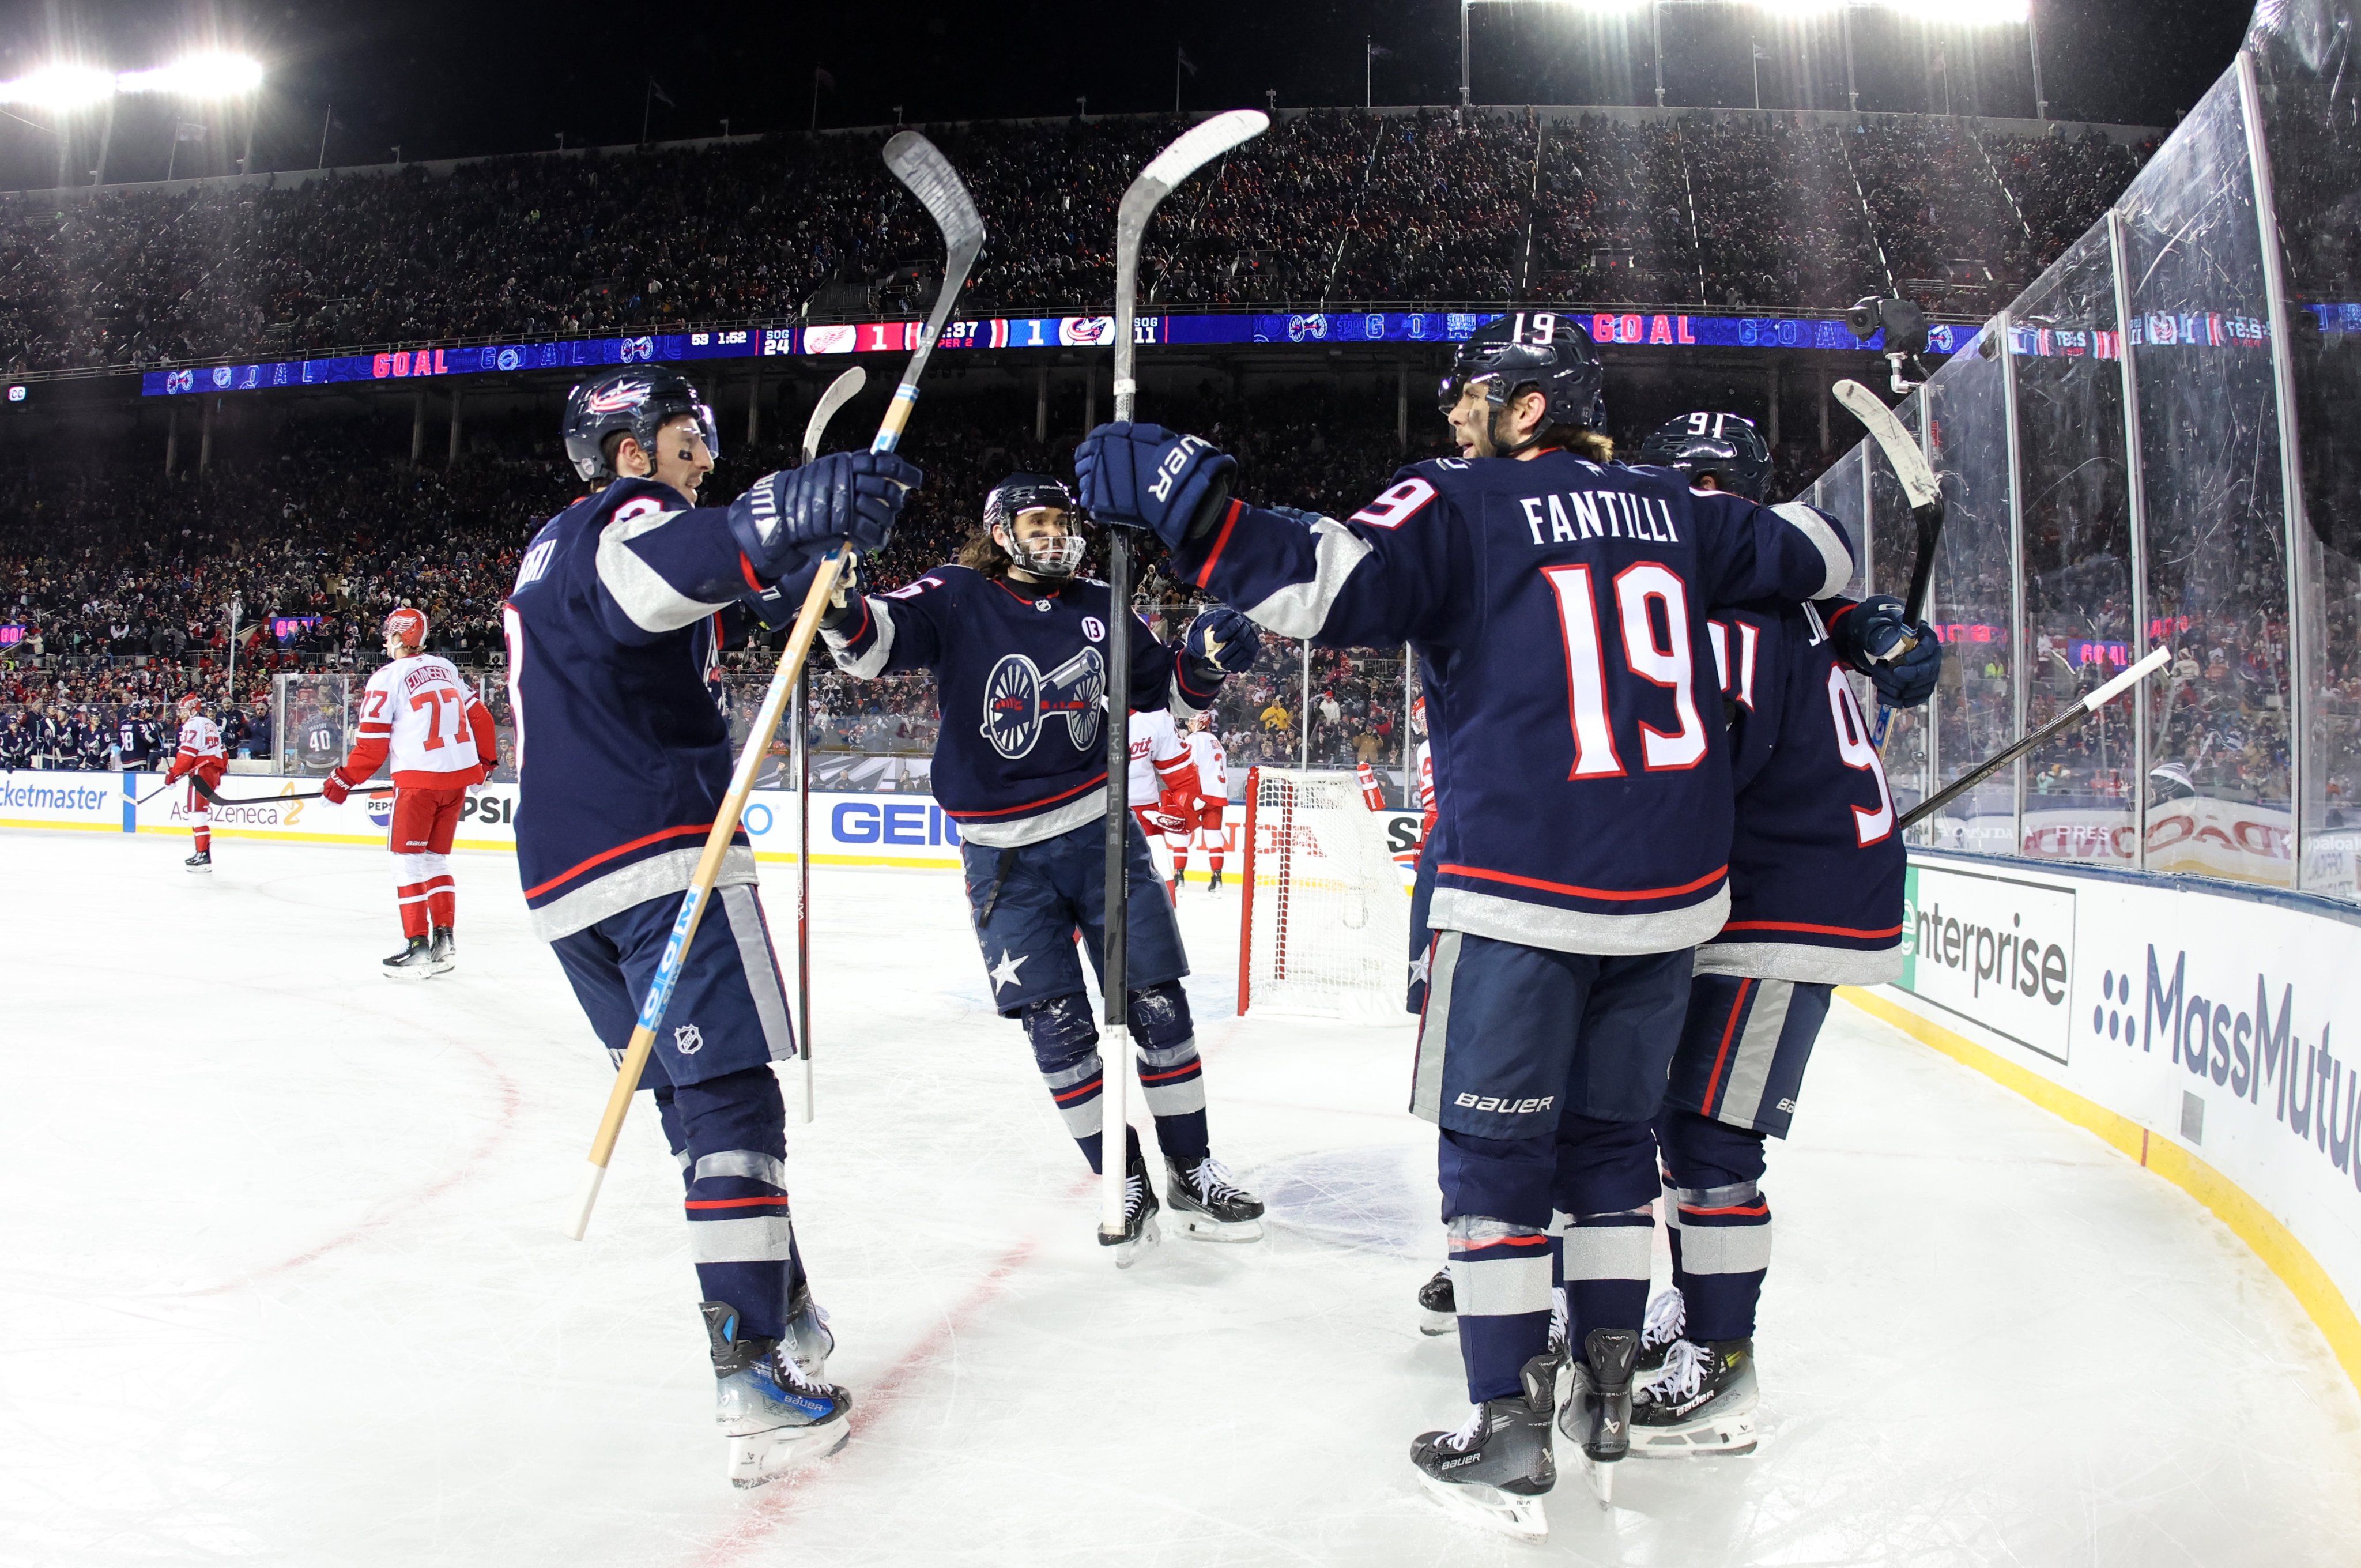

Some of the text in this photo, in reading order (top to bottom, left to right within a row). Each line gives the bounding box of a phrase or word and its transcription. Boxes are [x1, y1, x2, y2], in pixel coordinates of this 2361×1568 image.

[942, 321, 978, 338] :37
[1028, 320, 1044, 345] 1
[1134, 317, 1158, 327] SOG
[1511, 312, 1555, 345] 19
[1593, 314, 1695, 344] GOAL
[692, 331, 747, 345] 53 1:52
[766, 330, 789, 340] SOG
[872, 326, 887, 350] 1
[965, 338, 974, 347] 2
[1134, 327, 1156, 343] 11
[764, 340, 789, 355] 24
[372, 349, 448, 378] GOAL
[1687, 412, 1724, 439] 91
[1519, 491, 1679, 545] FANTILLI
[1086, 620, 1101, 638] 13
[2080, 644, 2127, 665] GOAL
[1540, 560, 1708, 780] 19
[360, 691, 387, 718] 77
[410, 688, 470, 752] 77
[310, 730, 330, 752] 40
[1827, 661, 1895, 849] 9
[170, 801, 277, 825] AsaZeneca
[642, 888, 698, 1021] CCM
[1902, 898, 2067, 1006] enterprise
[2144, 944, 2361, 1193] MassMutu
[1454, 1091, 1554, 1114] BAUER
[784, 1395, 823, 1412] BAUER
[1676, 1389, 1715, 1416] BAUER
[1441, 1452, 1481, 1472] BAUER
